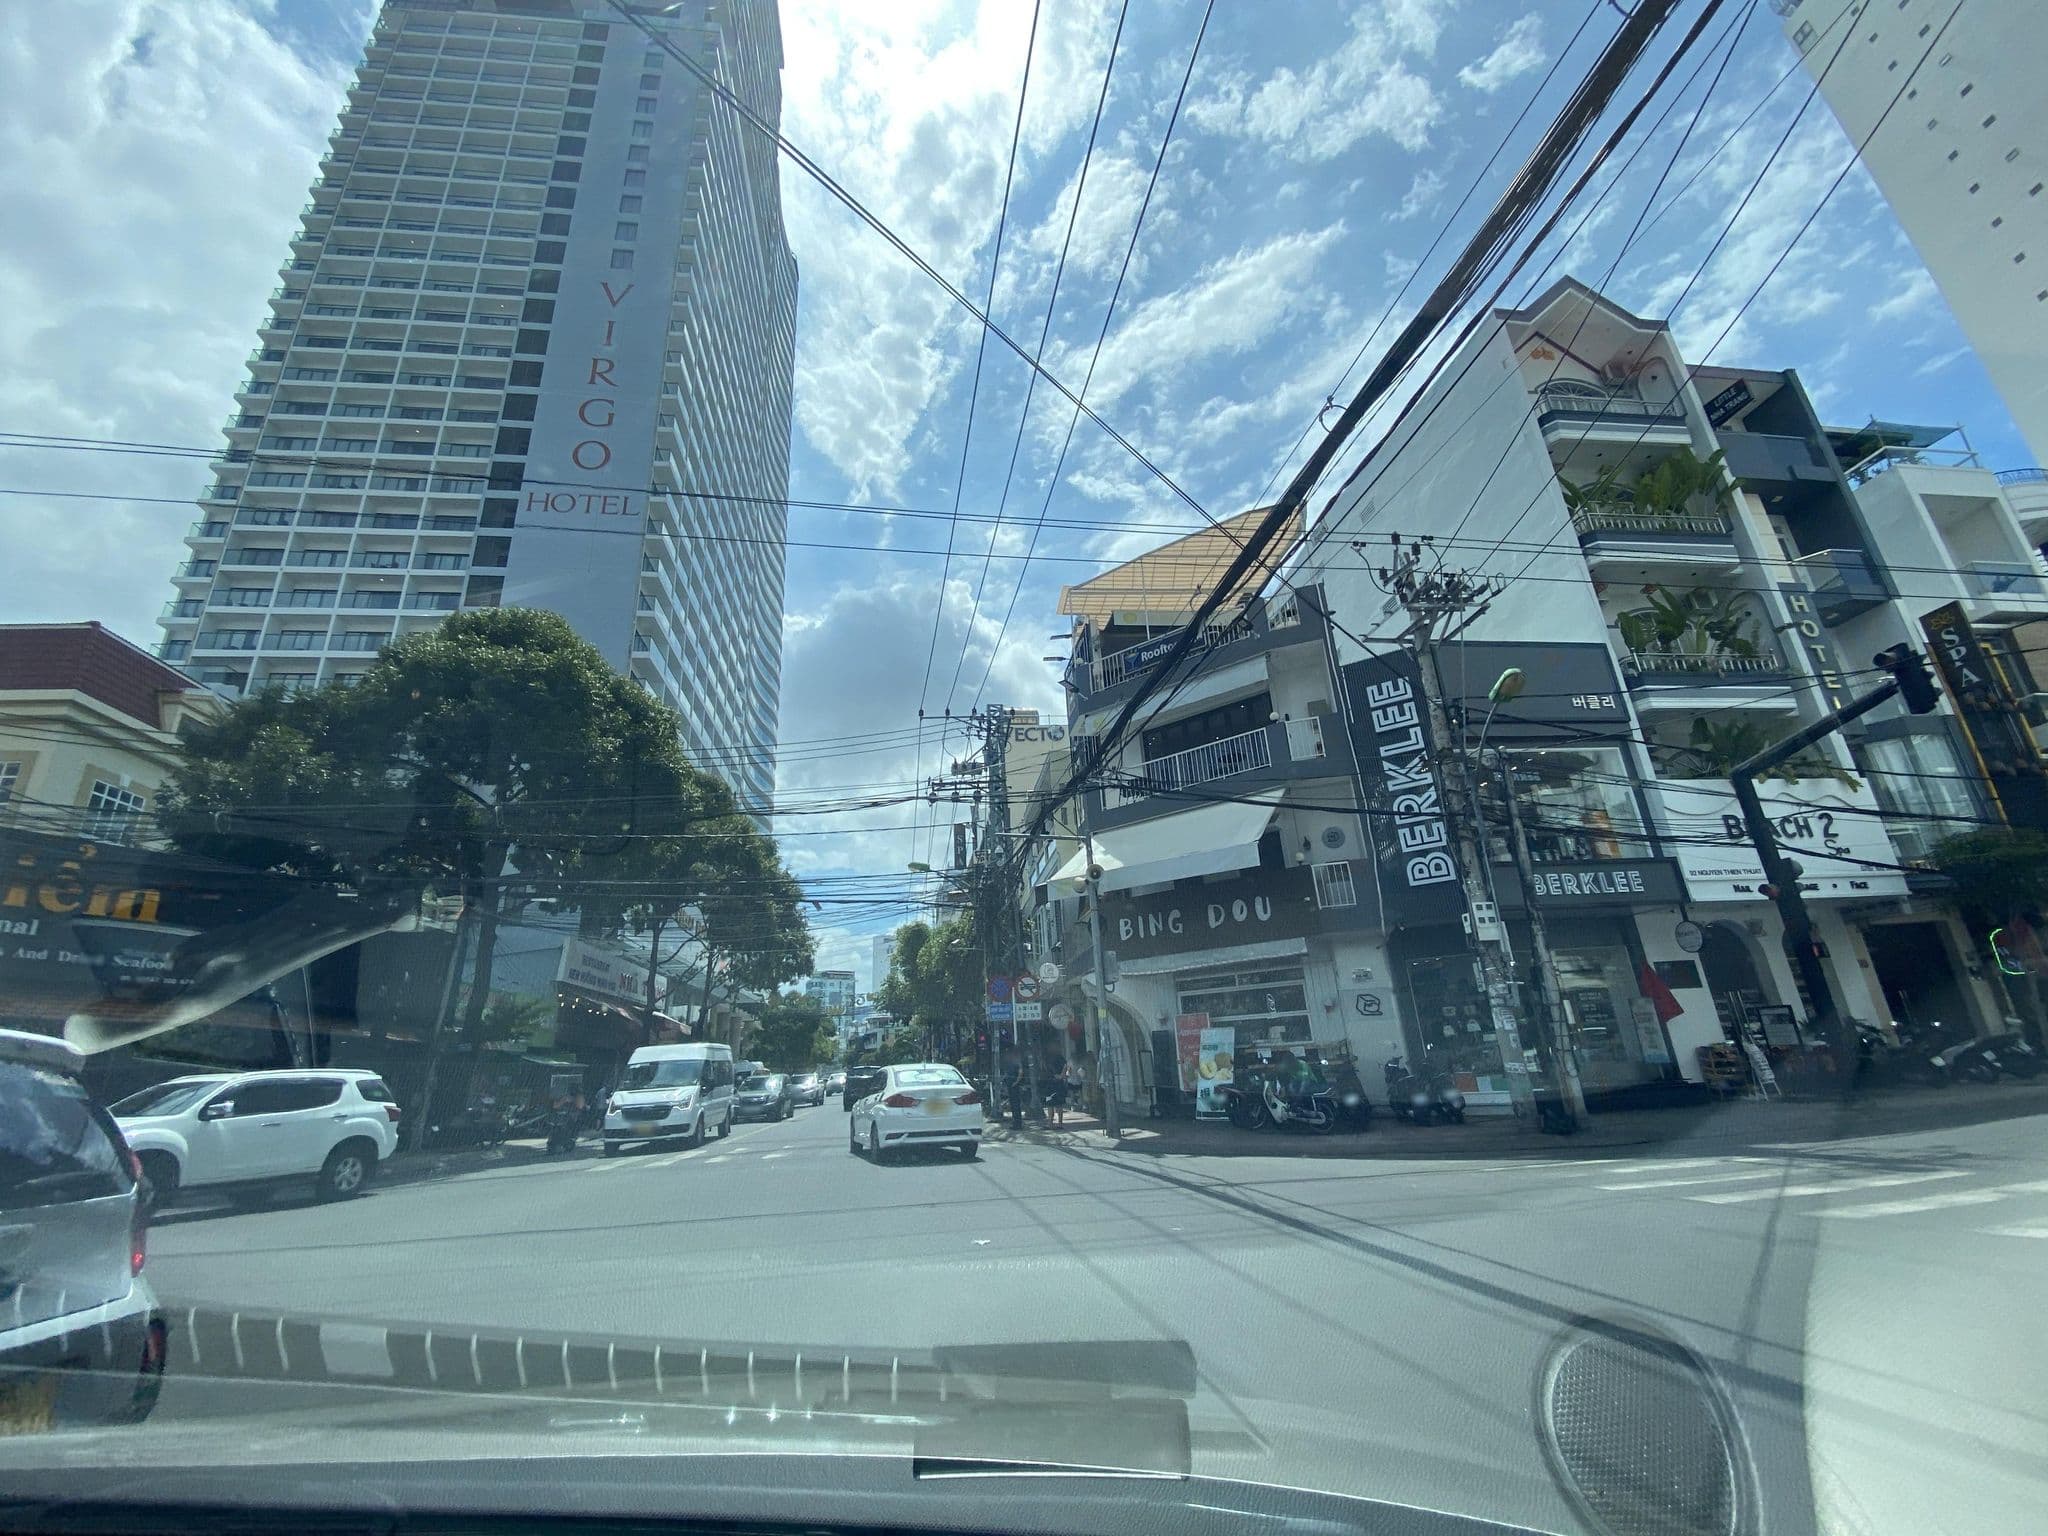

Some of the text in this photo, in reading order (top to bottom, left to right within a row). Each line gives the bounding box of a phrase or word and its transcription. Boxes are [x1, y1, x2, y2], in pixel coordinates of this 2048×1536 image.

[572, 282, 634, 470] VIRGO
[526, 491, 641, 517] HOTEL
[1140, 640, 1178, 663] Roofto
[1940, 626, 1982, 688] SPA
[1571, 695, 1616, 710] 버클리
[1366, 676, 1457, 887] BERKLEE
[1722, 812, 1839, 840] BCH 2
[1824, 839, 1851, 857] Spa
[1532, 871, 1645, 896] BERKLEE
[1119, 895, 1272, 941] BING DOU
